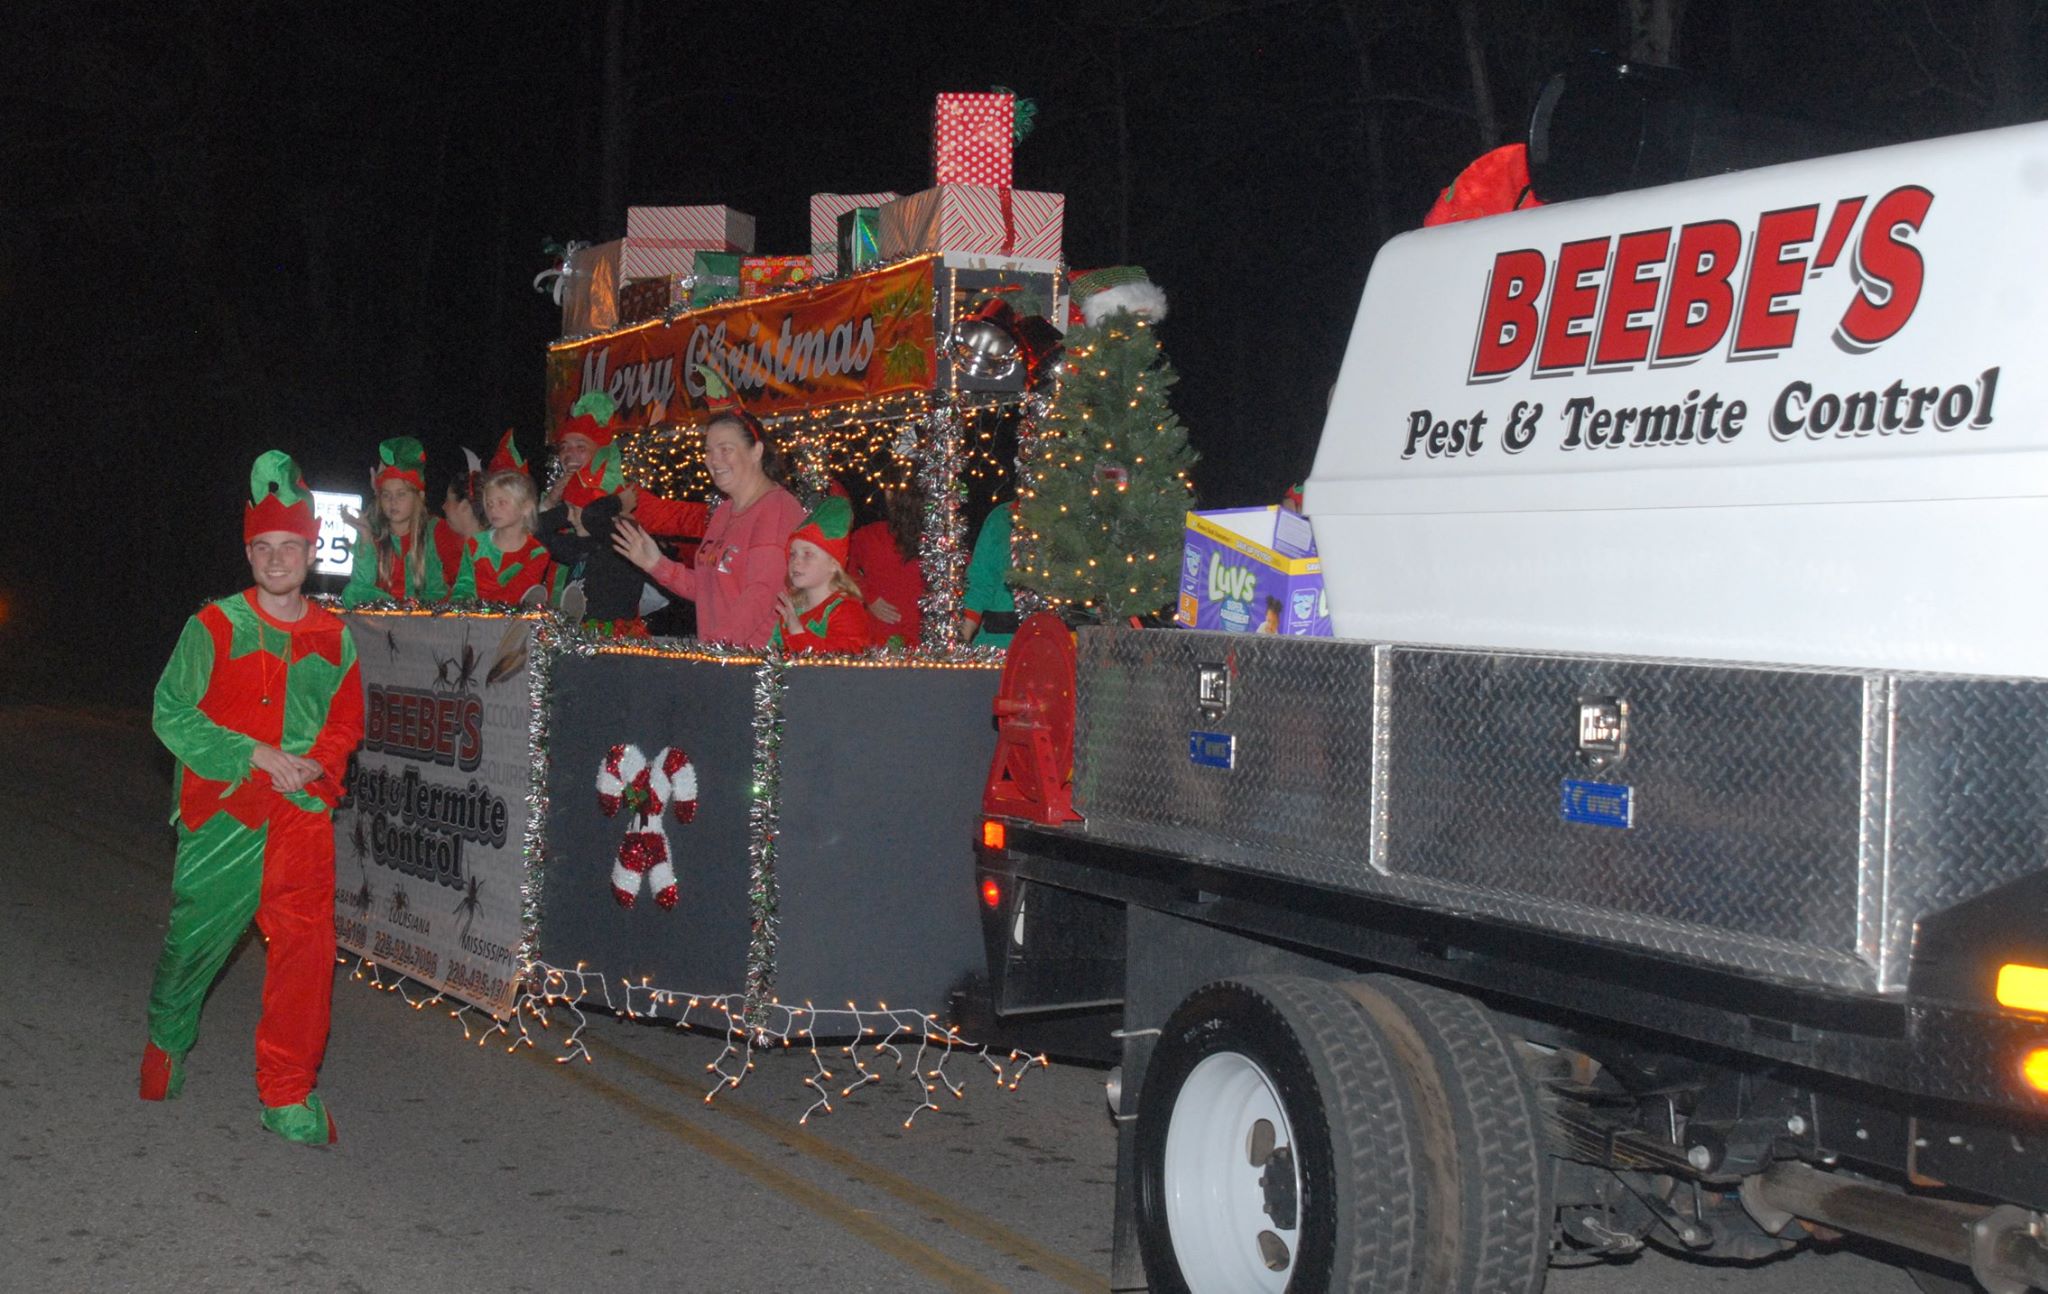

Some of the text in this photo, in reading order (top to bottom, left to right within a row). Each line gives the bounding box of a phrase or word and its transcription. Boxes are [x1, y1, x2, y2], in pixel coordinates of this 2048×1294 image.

[1467, 184, 1935, 384] BEEBE'S
[570, 315, 876, 424] Merry Christmas
[1401, 366, 2002, 460] Pest & Termite Control
[1208, 551, 1256, 602] Luvs
[367, 685, 483, 771] BEEBE'S
[345, 753, 389, 808] Pest
[402, 766, 508, 845] Termite
[372, 810, 466, 884] Control
[388, 906, 430, 936] LOUISIANA
[461, 933, 513, 967] MISSISSIPPI
